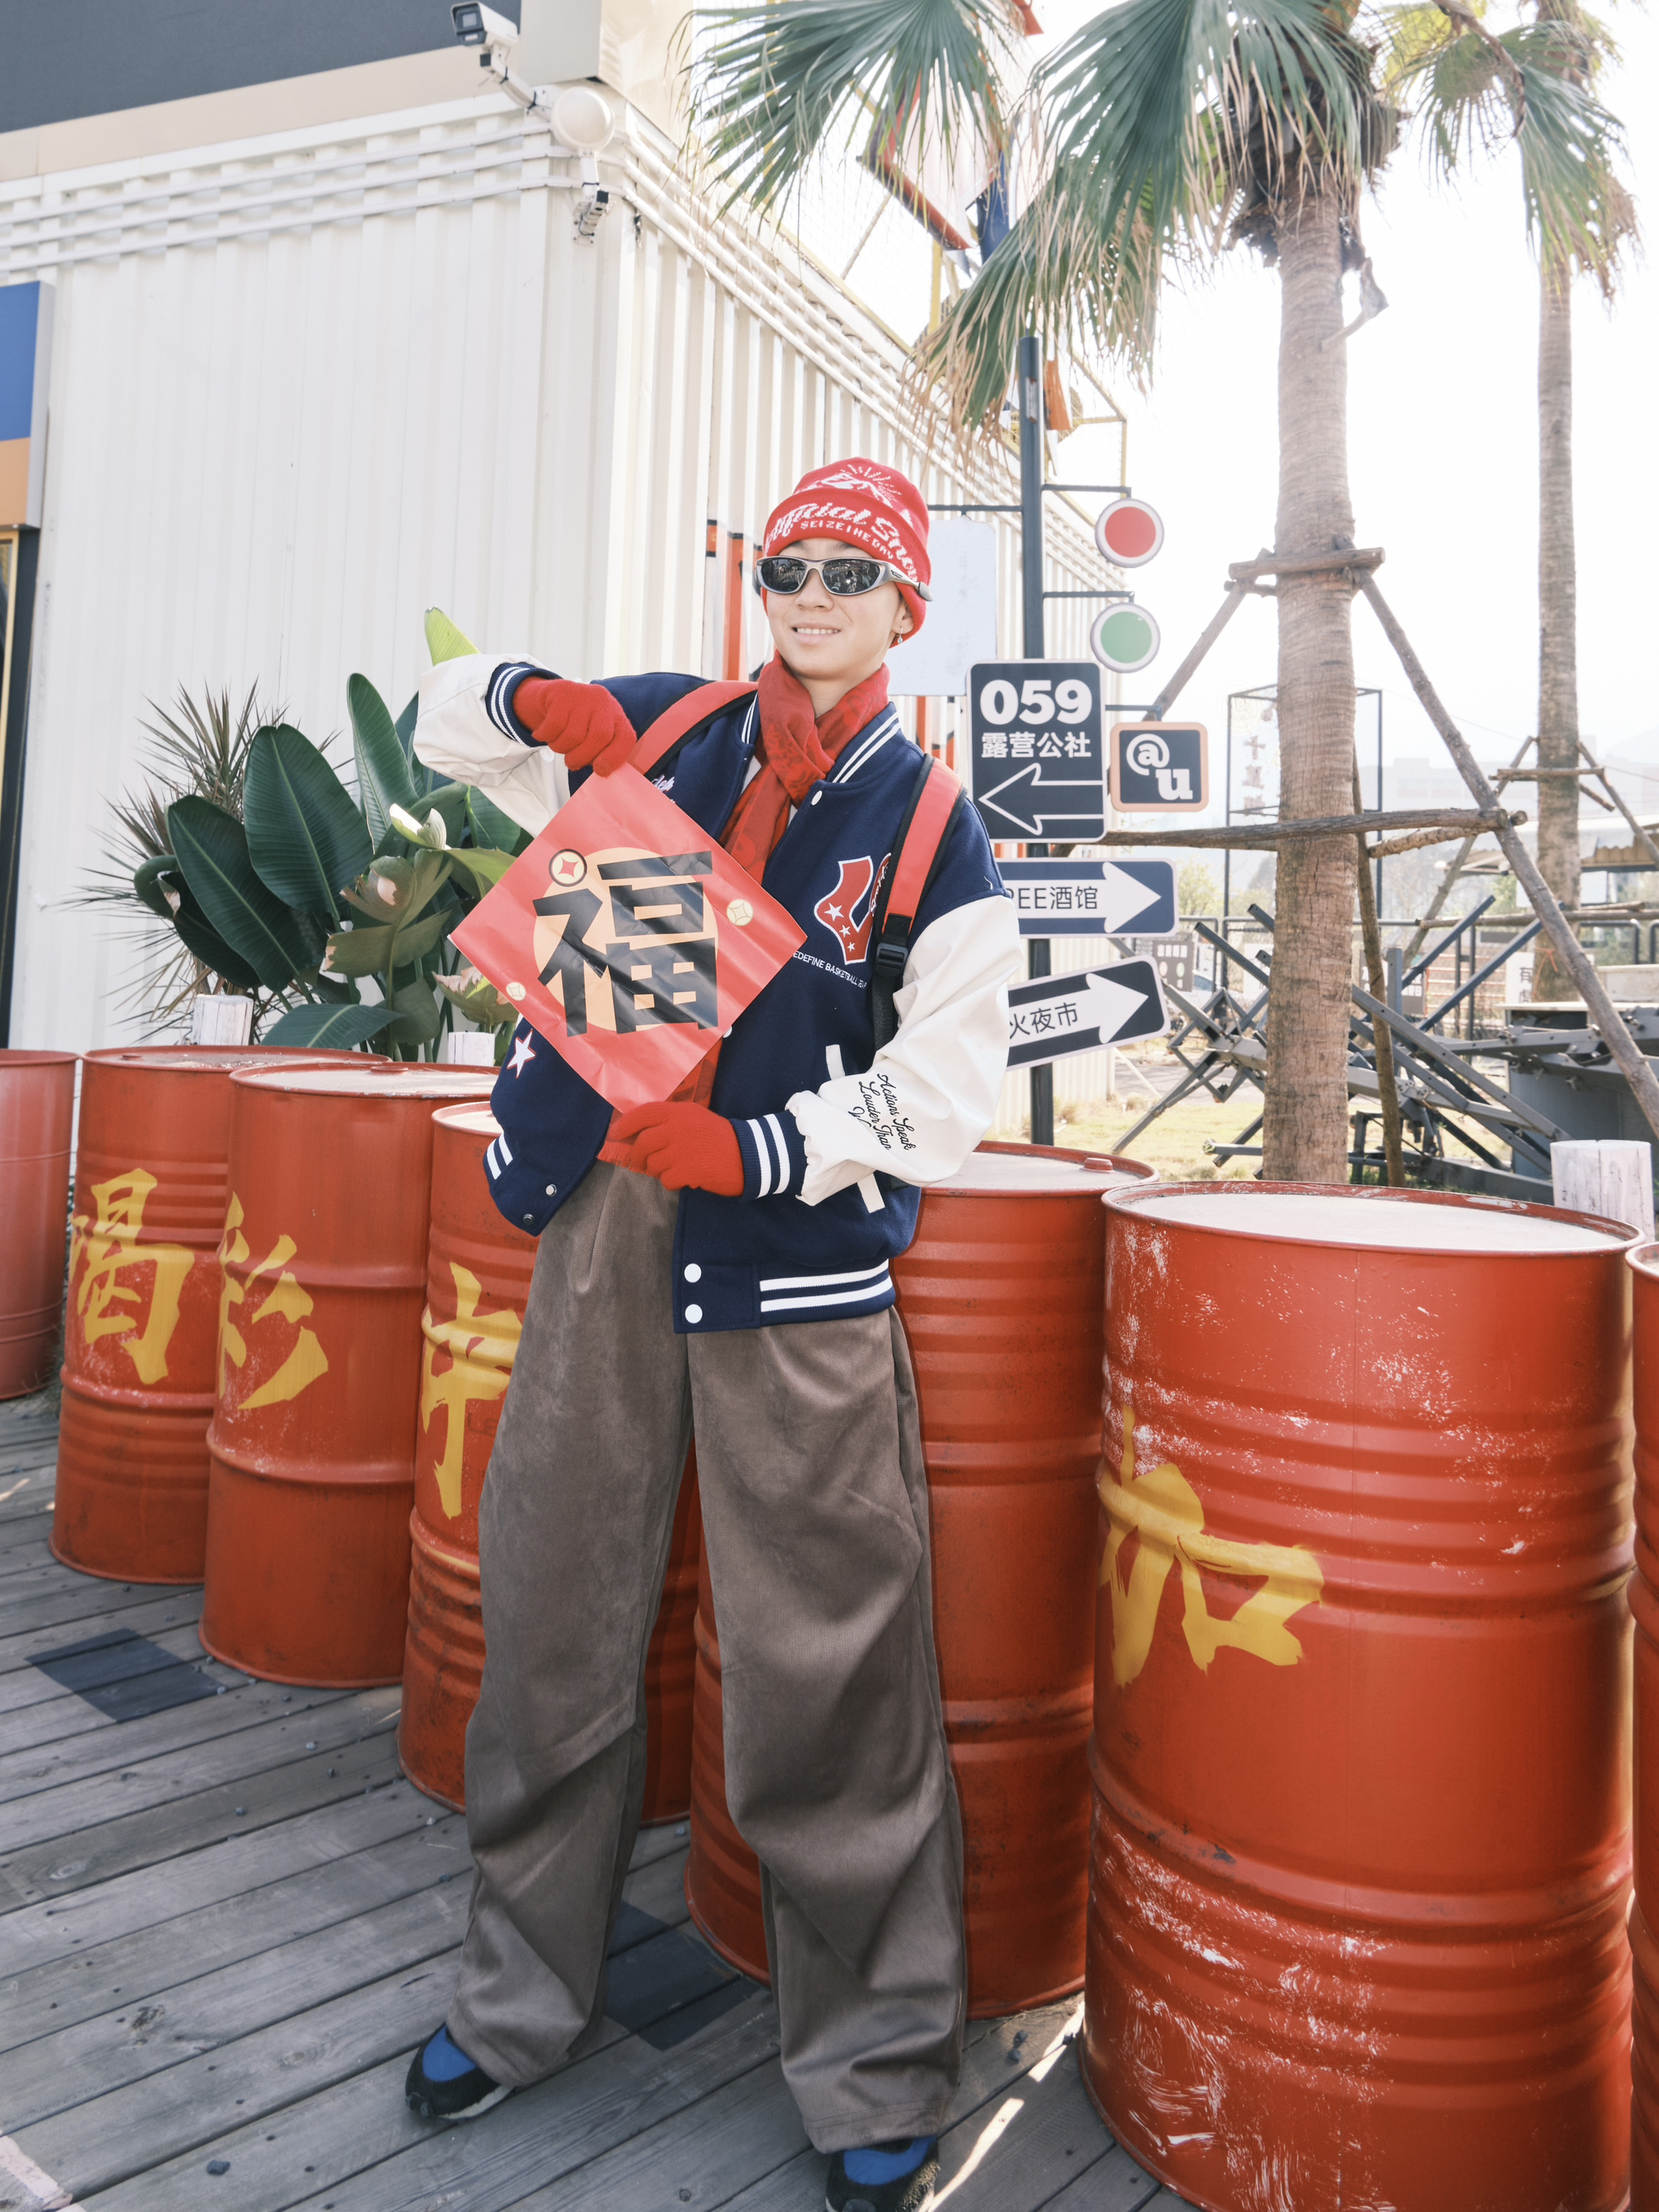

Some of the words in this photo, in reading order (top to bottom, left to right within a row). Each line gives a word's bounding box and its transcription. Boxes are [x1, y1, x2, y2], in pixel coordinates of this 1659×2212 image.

[801, 519, 844, 531] SEIZE
[980, 679, 1093, 725] 059
[981, 732, 1091, 758] 露营公社
[532, 848, 718, 1038] 福
[825, 963, 857, 985] BASKETBALL
[1010, 1002, 1078, 1039] 火夜市
[858, 1081, 881, 1123] Louder
[873, 1125, 894, 1150] Than
[877, 1074, 899, 1116] Actions
[891, 1118, 917, 1150] Speak
